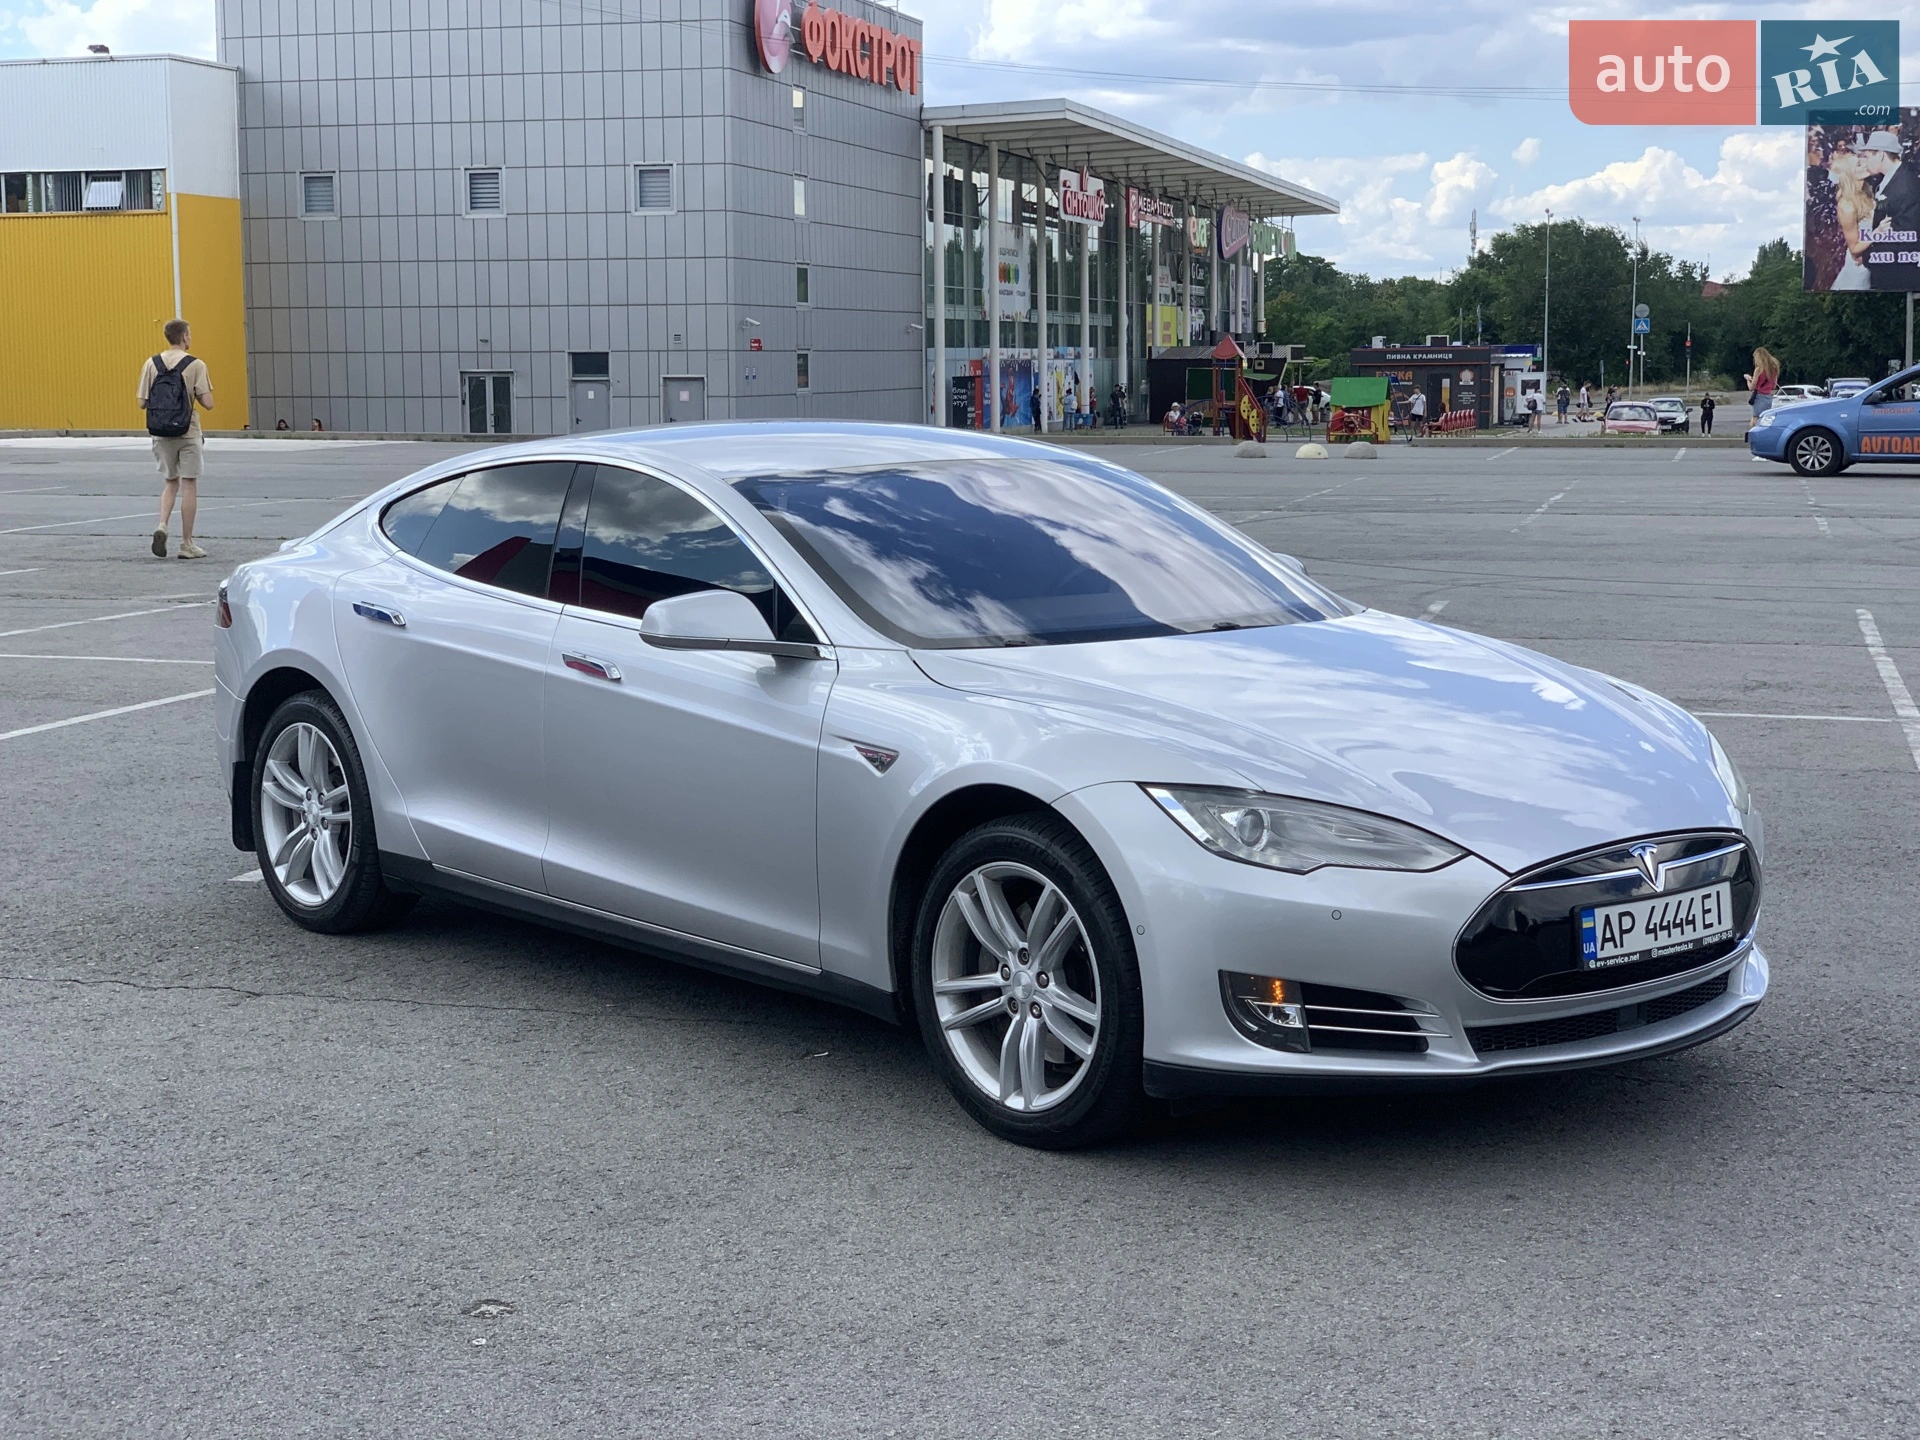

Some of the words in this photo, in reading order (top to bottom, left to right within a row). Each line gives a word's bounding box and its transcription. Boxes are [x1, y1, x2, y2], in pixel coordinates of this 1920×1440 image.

[801, 0, 922, 95] ФОКСТРОТ
[1859, 229, 1917, 242] Кожен
[1869, 252, 1894, 263] ми
[1600, 910, 1636, 951] AP
[1645, 897, 1697, 942] 4444
[1701, 890, 1722, 930] EI
[1583, 942, 1596, 954] UA
[1596, 953, 1640, 968] ev-service.net
